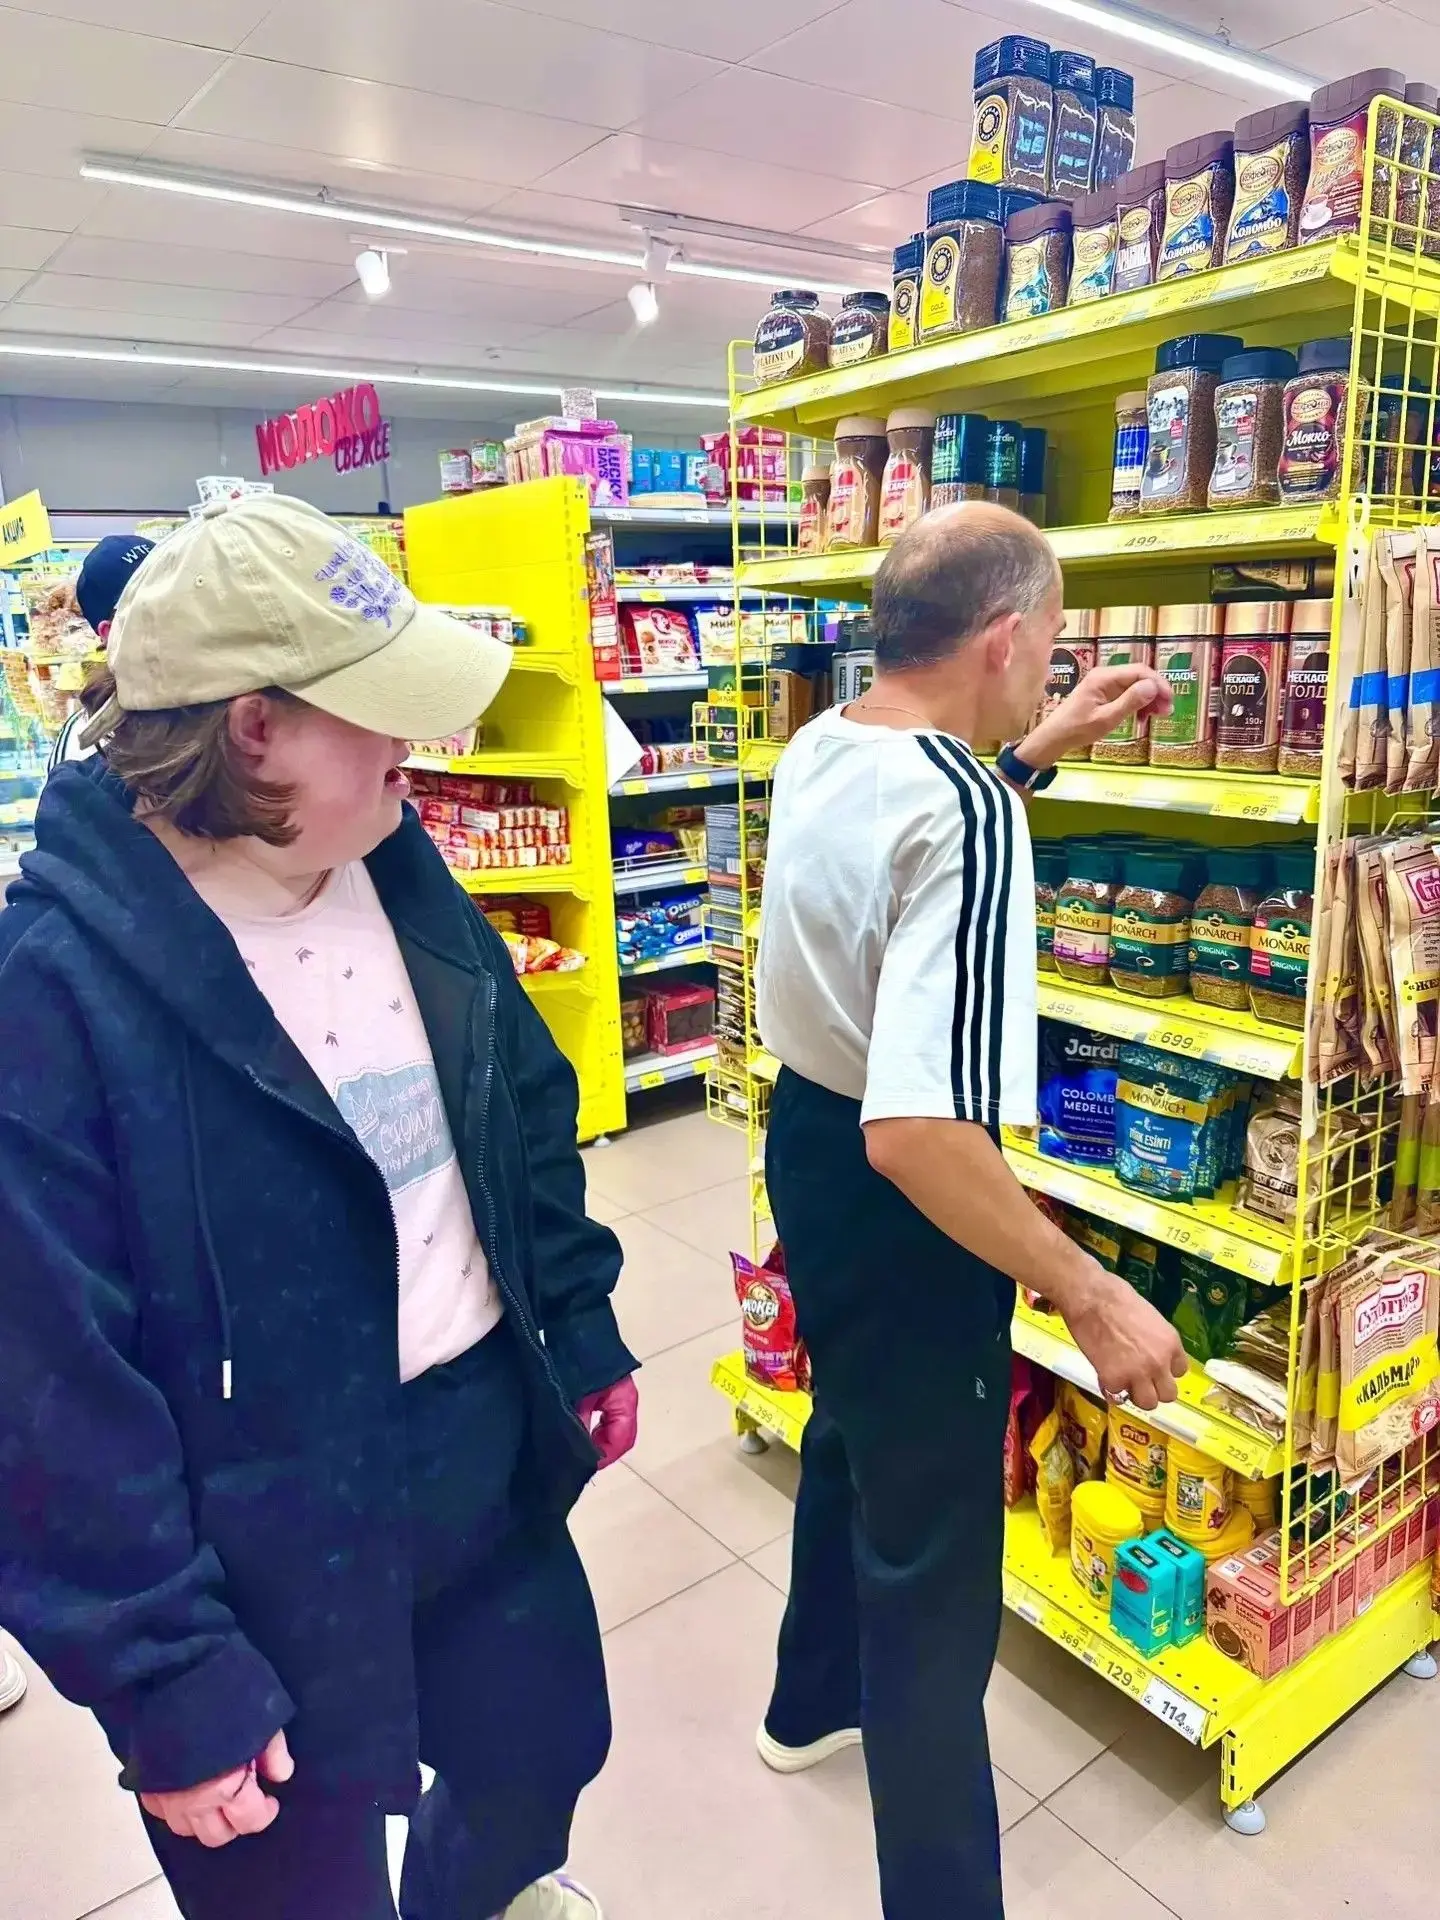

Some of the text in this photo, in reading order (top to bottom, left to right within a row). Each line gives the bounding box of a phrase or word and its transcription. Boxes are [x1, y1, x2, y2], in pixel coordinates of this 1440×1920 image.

[1231, 217, 1282, 240] Коломбо
[1161, 240, 1206, 262] Коломбо
[930, 302, 945, 312] GOLD
[256, 383, 381, 476] МОЛОКО
[988, 433, 1015, 442] Jardin
[335, 422, 390, 473] СВЕЖЕЕ
[1287, 431, 1331, 447] Мокко
[597, 448, 608, 478] DAYS
[608, 448, 622, 499] LUCKY
[1125, 536, 1157, 547] 499
[1223, 674, 1260, 684] НЕСКАФЕ
[1287, 673, 1328, 683] НЕСКАФ
[1225, 685, 1255, 695] ГОЛД
[1289, 685, 1328, 699] ГОЛД
[1242, 805, 1268, 817] 699
[668, 899, 699, 916] OREO
[674, 927, 702, 944] OREO
[1189, 925, 1242, 942] MONARCH
[1115, 942, 1144, 954] ORIGINAL
[1198, 945, 1229, 957] ORIGINAL
[1258, 936, 1311, 955] MONARC
[1270, 961, 1303, 972] ORIGINAL
[1065, 1039, 1119, 1059] Jardi
[1061, 1087, 1115, 1104] COLOMB
[1130, 1090, 1186, 1114] MONARCH
[1064, 1100, 1114, 1115] MEDELLI
[1227, 1445, 1249, 1462] 229
[1060, 1631, 1079, 1648] 369
